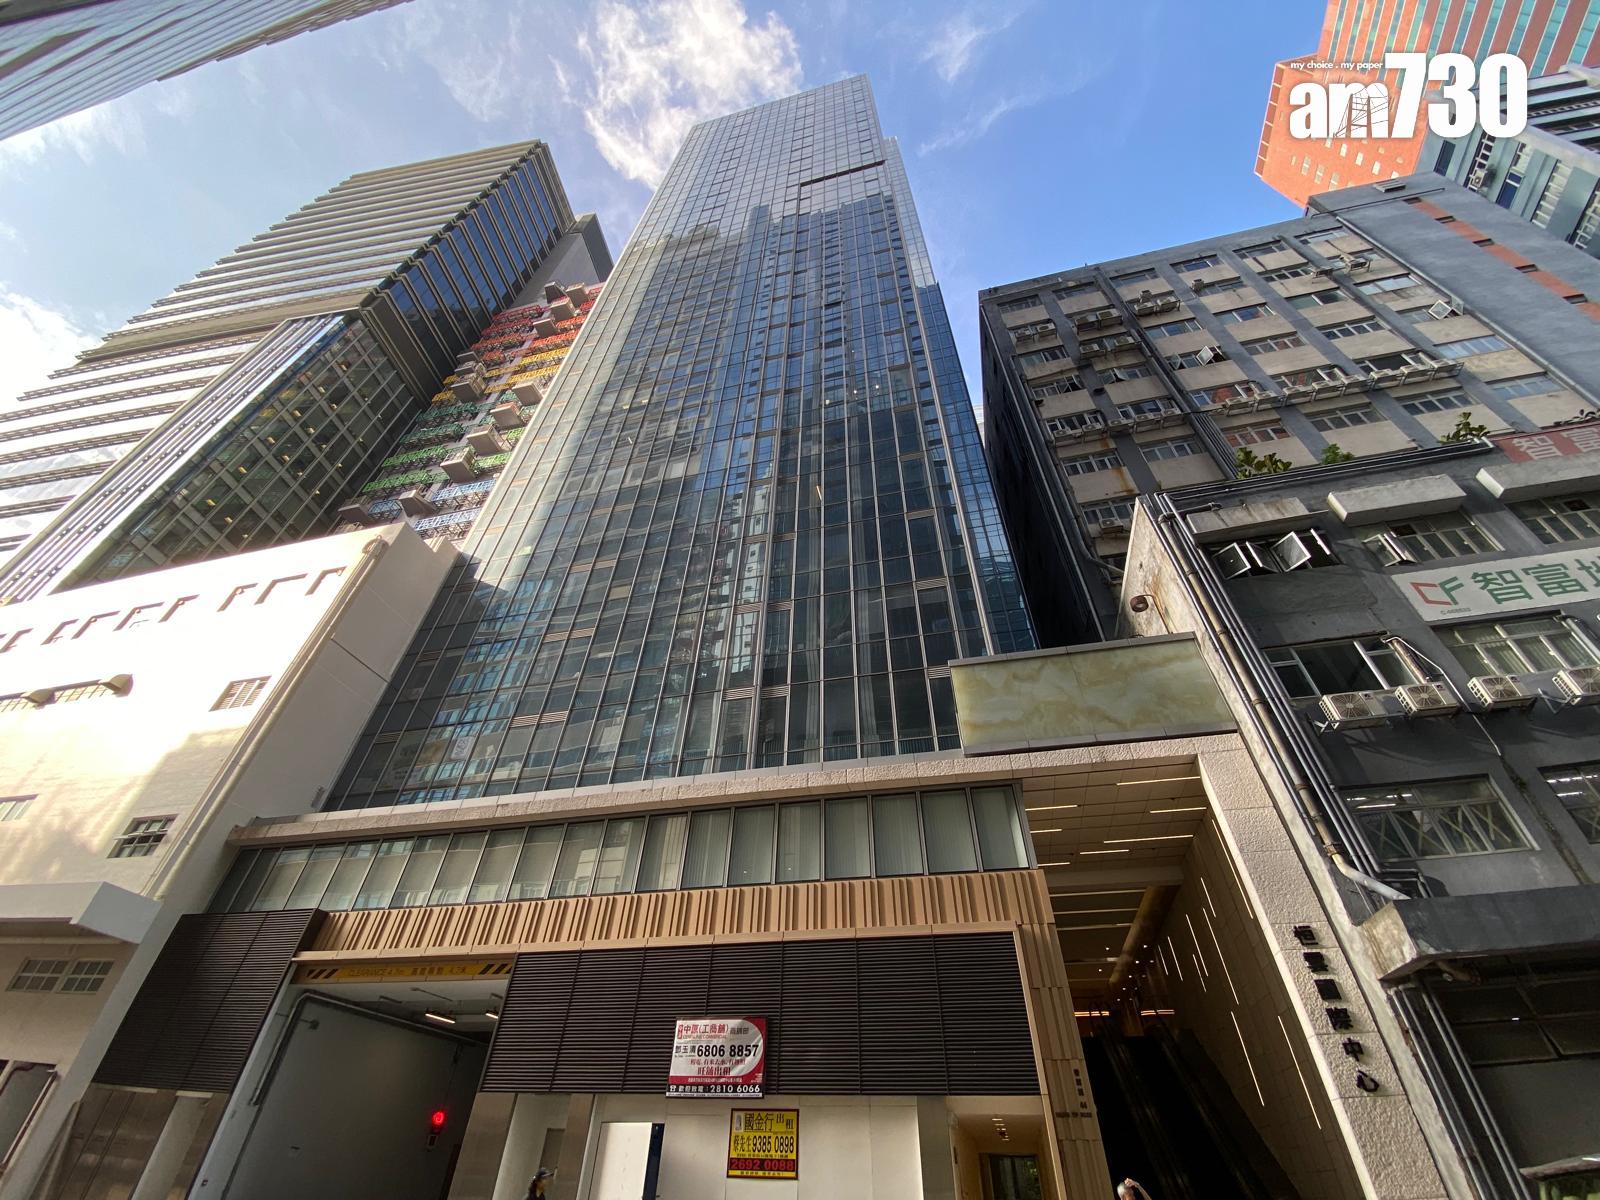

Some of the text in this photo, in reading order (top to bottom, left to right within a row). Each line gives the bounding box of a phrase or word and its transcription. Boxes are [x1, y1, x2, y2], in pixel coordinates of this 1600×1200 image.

[697, 1044, 725, 1057] 6806
[729, 1044, 759, 1057] 8857
[710, 1085, 733, 1093] 2810
[737, 1084, 760, 1093] 6066
[752, 1135, 772, 1153] 9385
[774, 1135, 795, 1153] 0898
[731, 1159, 794, 1171] 2692 0088
